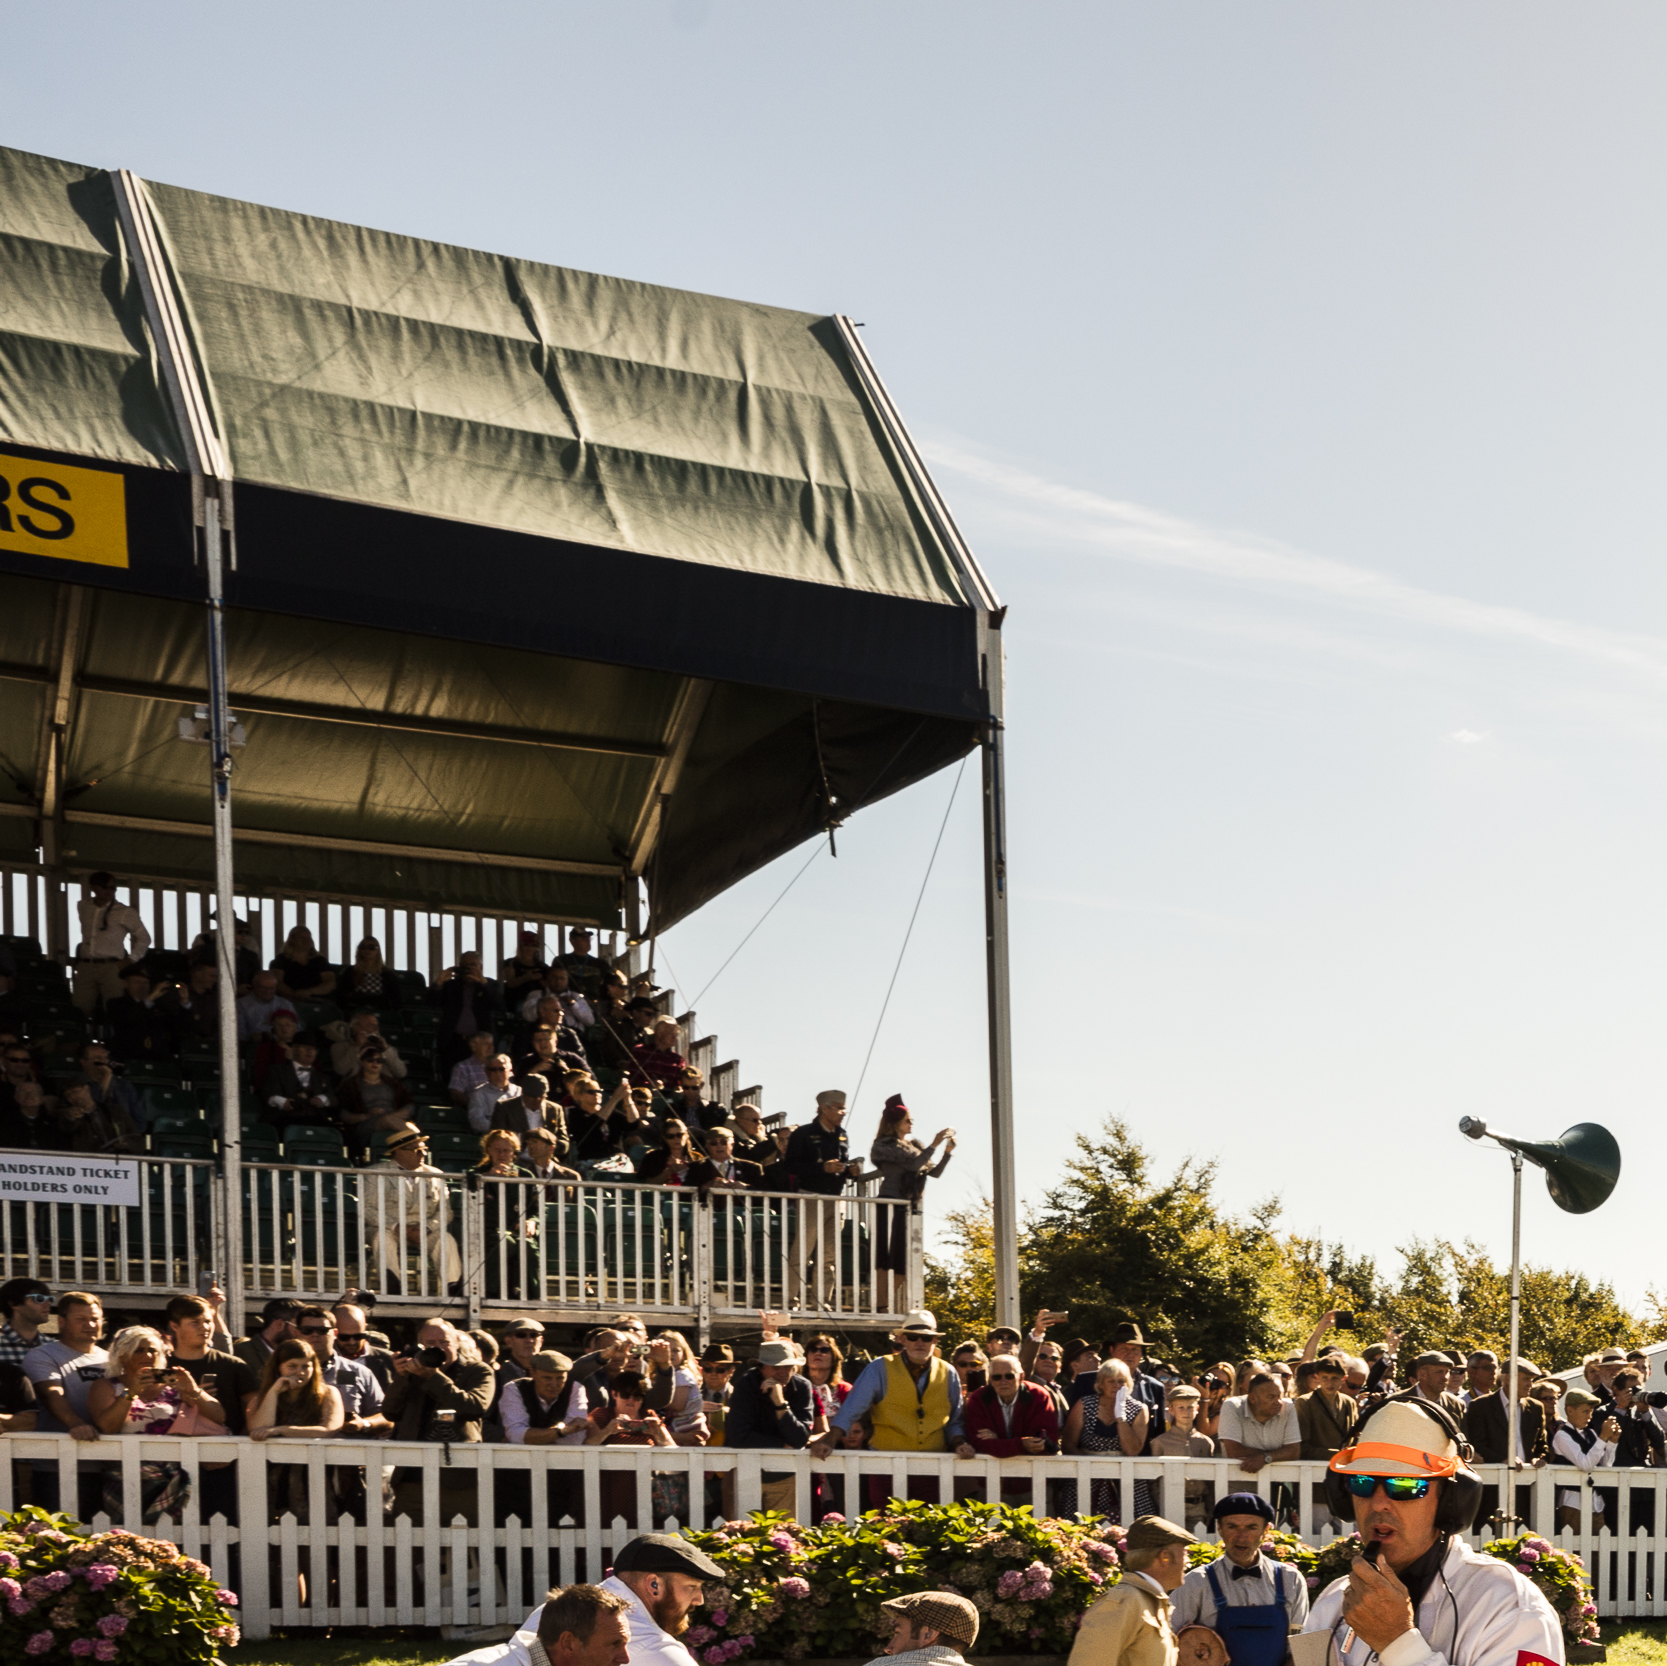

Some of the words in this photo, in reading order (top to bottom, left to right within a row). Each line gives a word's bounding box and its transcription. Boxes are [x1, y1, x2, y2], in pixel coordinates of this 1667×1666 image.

[0, 473, 76, 540] S
[80, 1167, 131, 1180] TICKET
[2, 1180, 69, 1194] HOLDERS
[73, 1184, 110, 1196] ONLY
